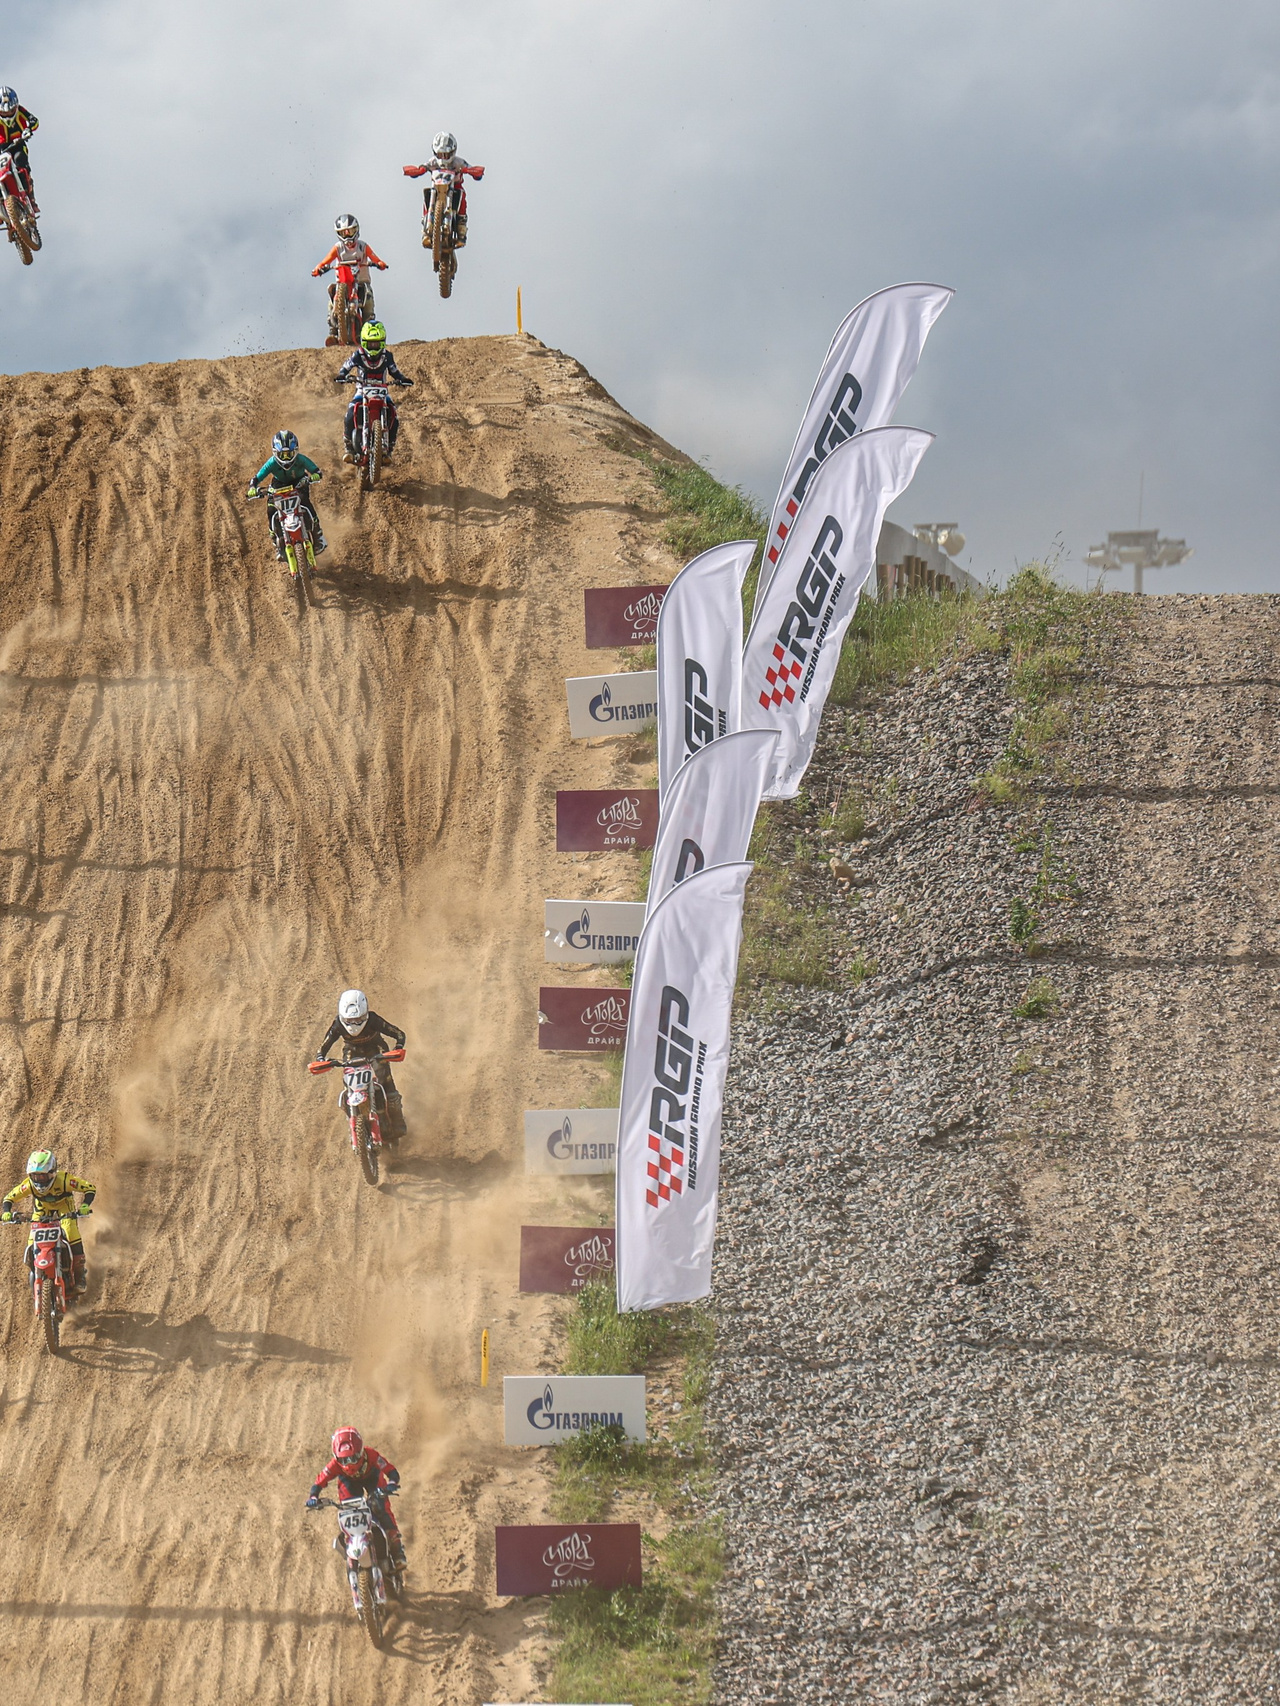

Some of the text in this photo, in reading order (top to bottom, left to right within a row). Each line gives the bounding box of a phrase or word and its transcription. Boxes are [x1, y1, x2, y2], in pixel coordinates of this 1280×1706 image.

[365, 388, 386, 396] 734
[777, 515, 843, 664] RGP
[631, 630, 657, 639] ДРАЙ
[799, 572, 846, 703] RUSSIAN GRAND PRIX
[614, 702, 658, 721] ГАЗПР
[684, 658, 714, 761] GP
[603, 836, 636, 845] ДРАЙВ
[592, 934, 640, 951] ГАЗПРО
[587, 1036, 621, 1045] ДРАЙВ
[649, 985, 695, 1149] RGP
[348, 1070, 372, 1086] 710
[686, 1040, 708, 1190] RUSSIAN GRAND PRIX
[574, 1143, 616, 1160] ГАЗПР
[35, 1229, 60, 1242] 613
[555, 1412, 623, 1430] ГАЗПРОМ
[345, 1513, 368, 1529] 454
